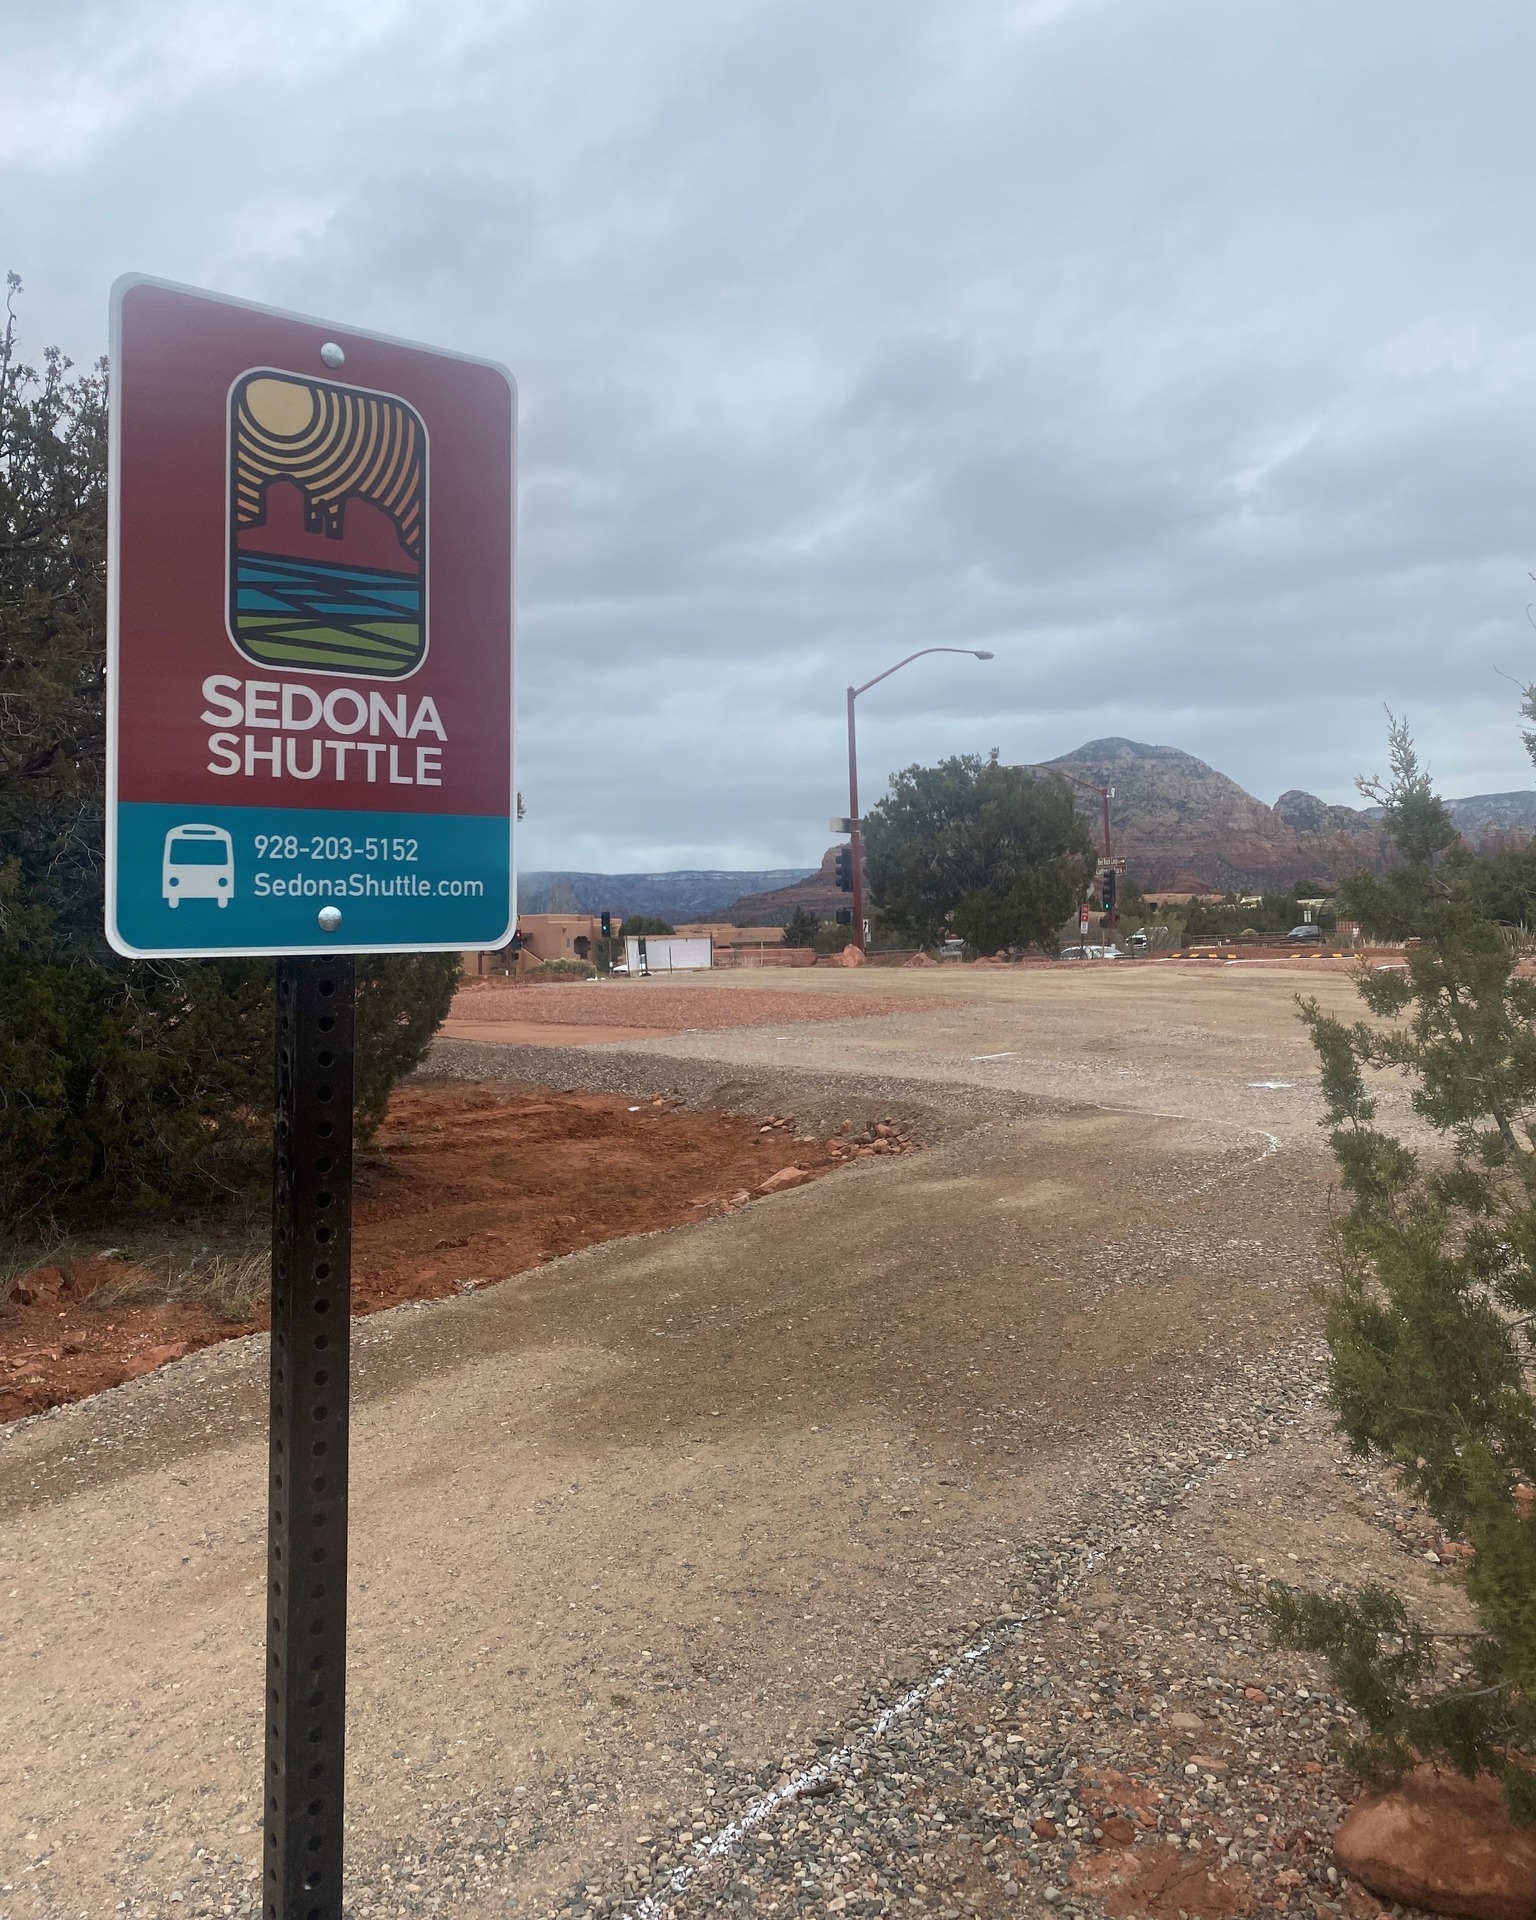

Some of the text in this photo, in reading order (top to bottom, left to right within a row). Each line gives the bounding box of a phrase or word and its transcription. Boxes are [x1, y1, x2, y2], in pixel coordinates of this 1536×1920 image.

[200, 674, 448, 741] SEDONA
[206, 732, 442, 785] SHUTTLE
[254, 834, 418, 861] 928-203-5152
[253, 872, 484, 897] SedonaShuttle.com
